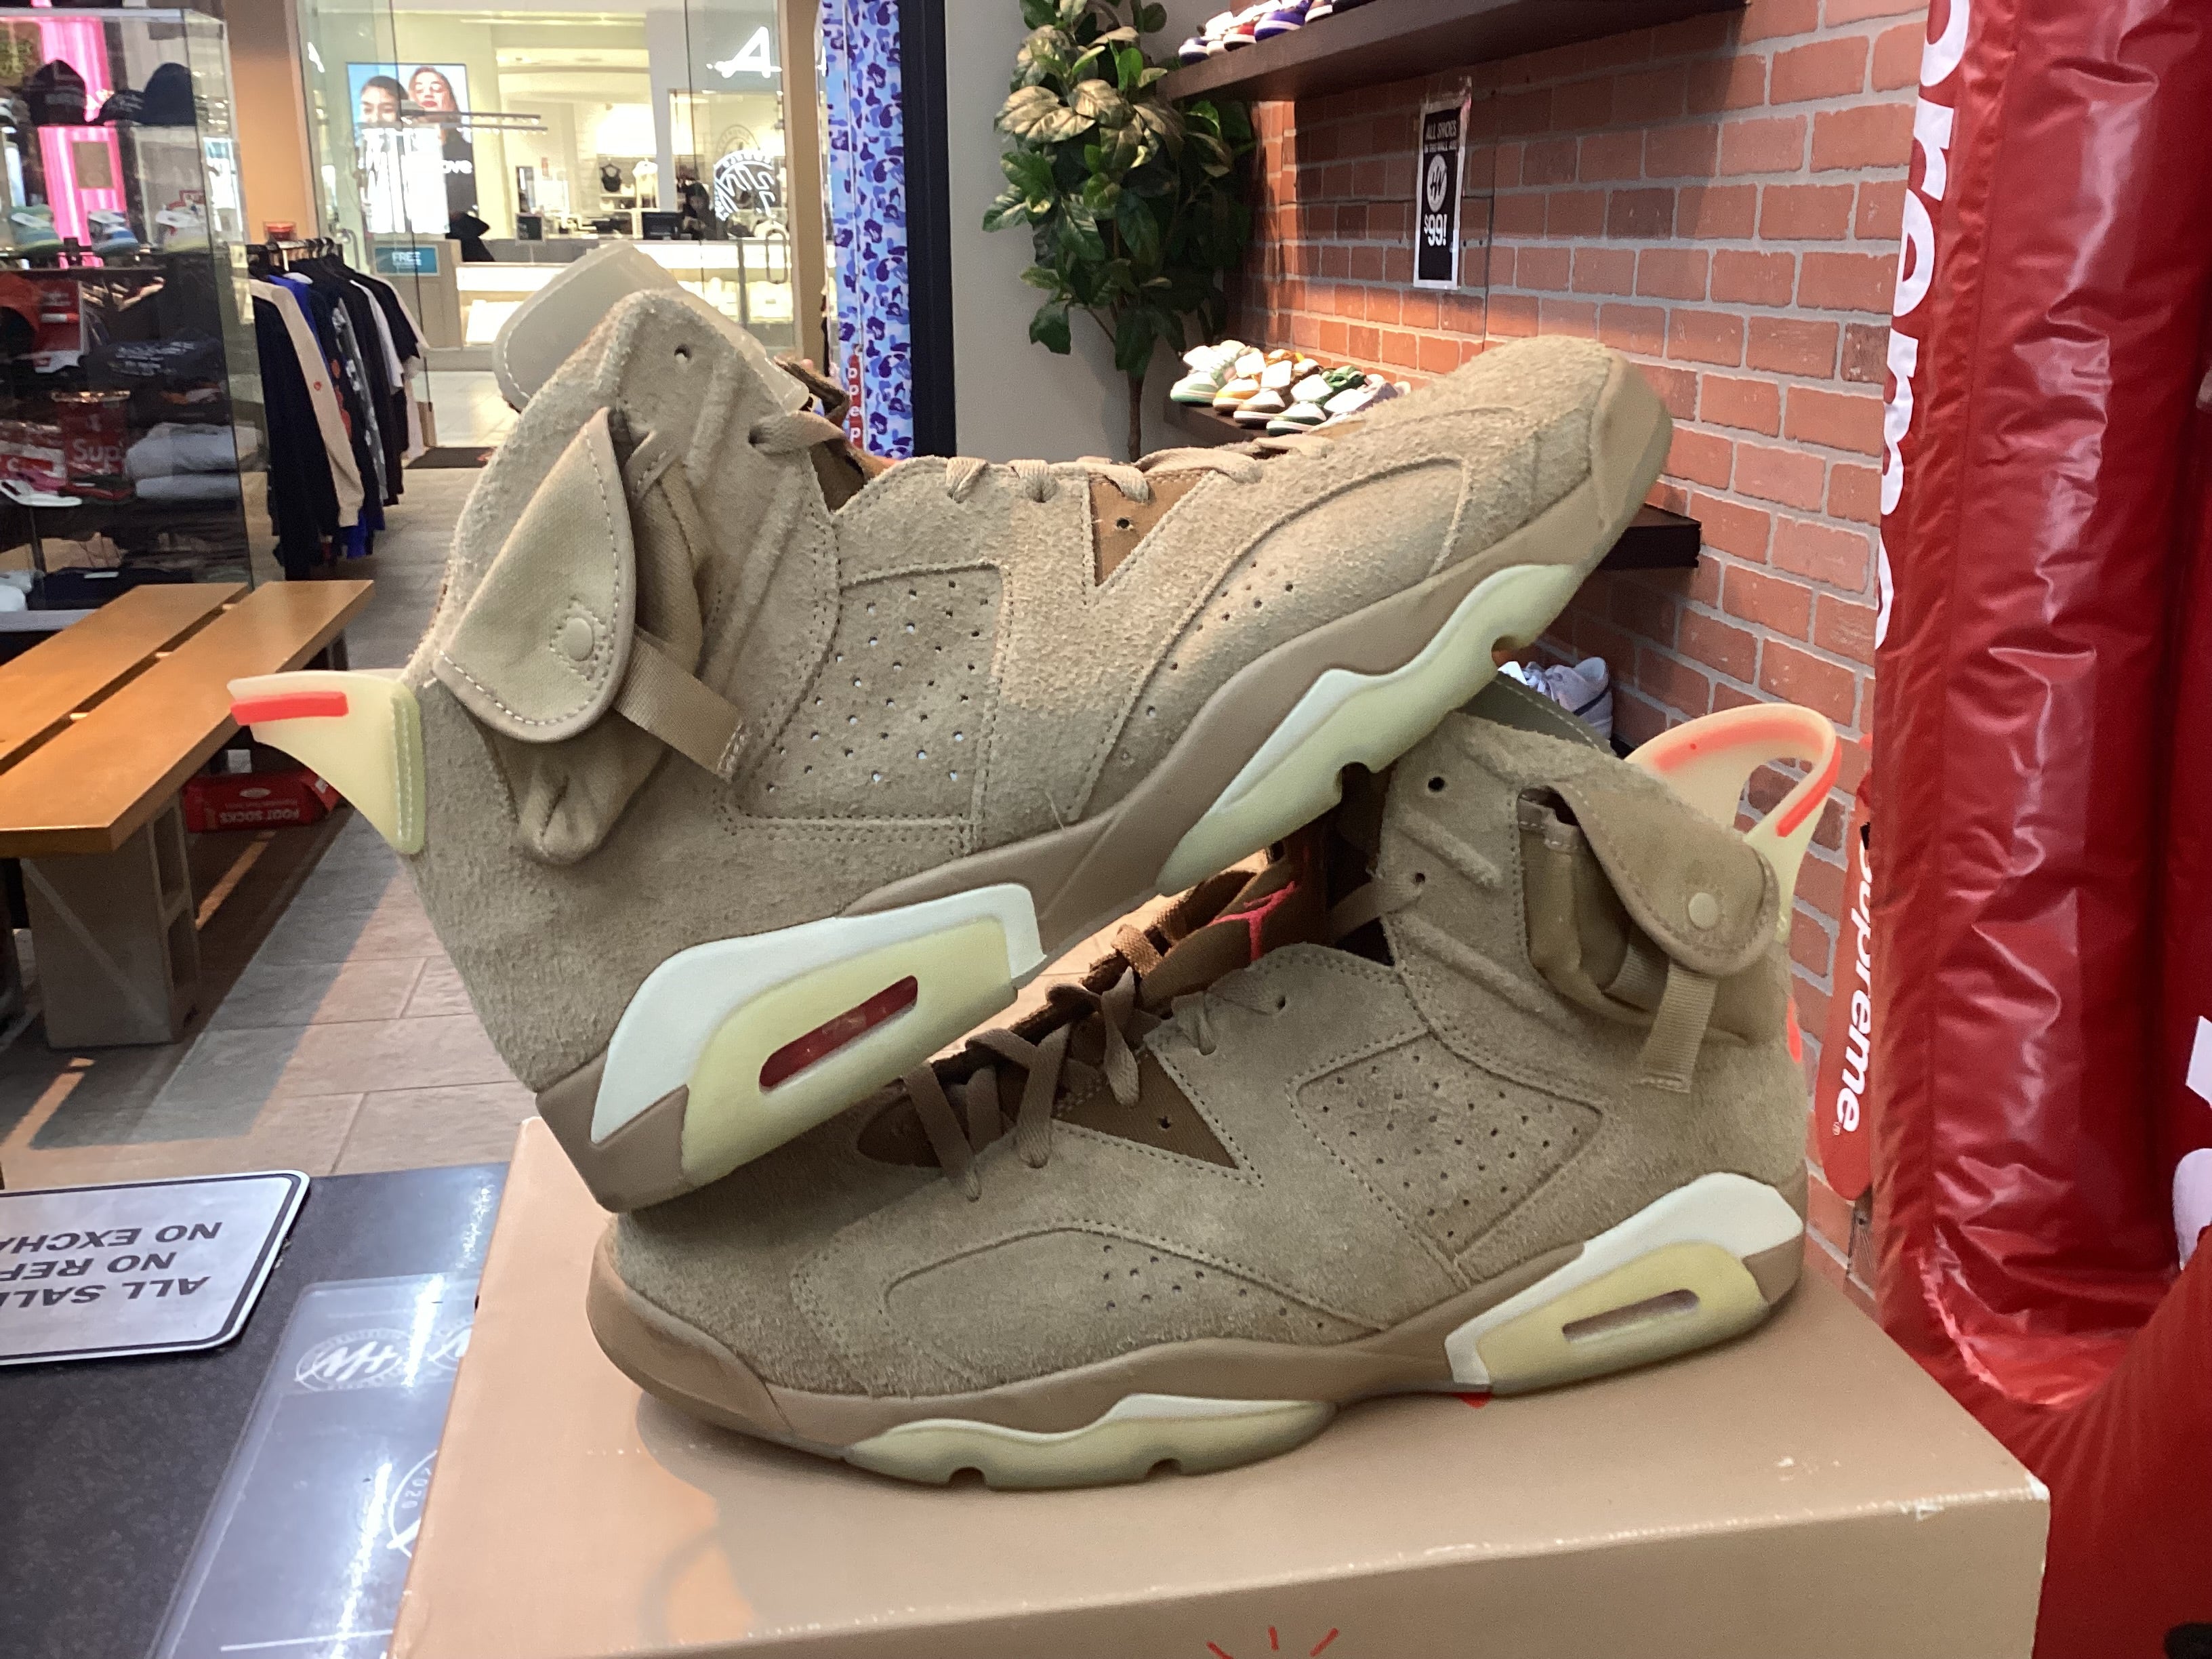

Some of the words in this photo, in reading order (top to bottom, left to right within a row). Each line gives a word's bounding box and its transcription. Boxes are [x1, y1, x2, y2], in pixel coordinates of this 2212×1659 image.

[1424, 213, 1448, 247] $99!
[155, 1222, 223, 1243] NO
[107, 1252, 178, 1273] NO
[122, 1276, 211, 1300] ALL
